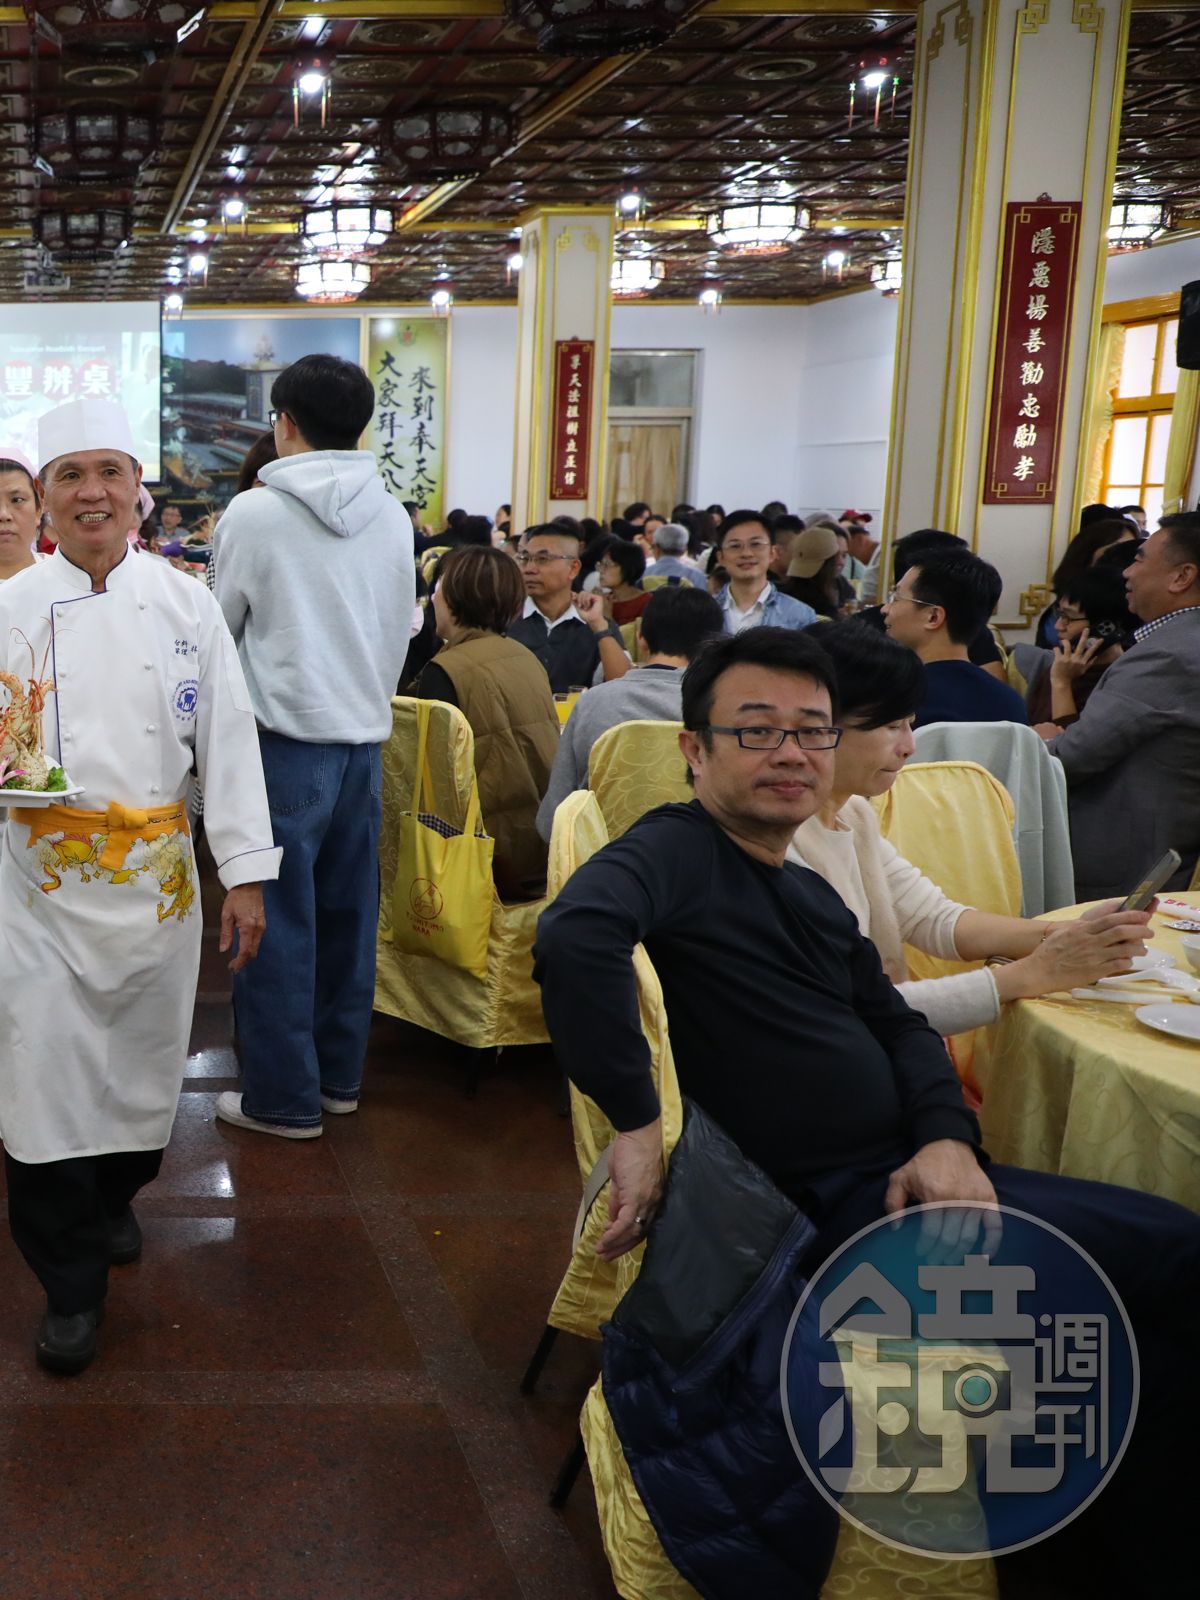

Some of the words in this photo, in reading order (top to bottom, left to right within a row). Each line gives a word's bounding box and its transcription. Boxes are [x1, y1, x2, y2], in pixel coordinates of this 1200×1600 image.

[4, 364, 111, 396] 豐辦桌
[408, 365, 437, 511] 來到奉天宮
